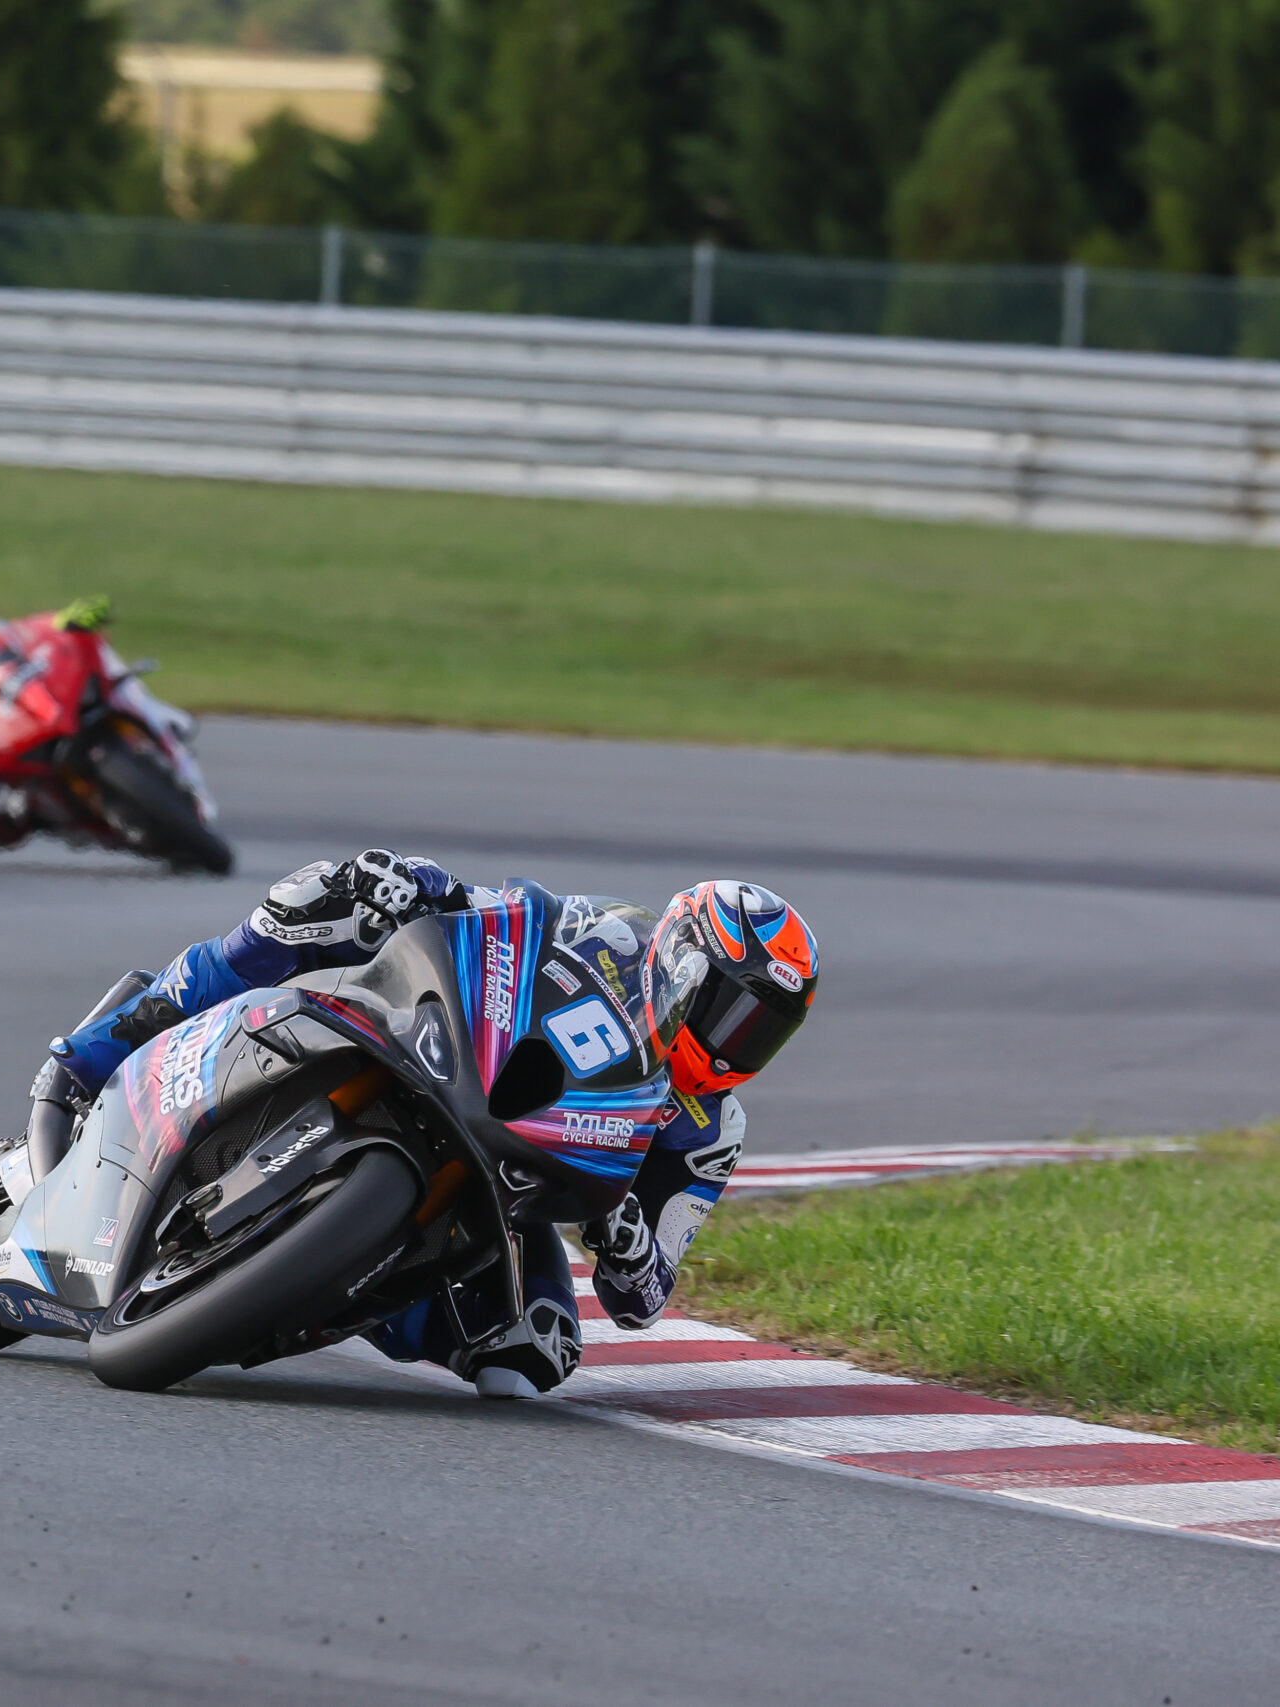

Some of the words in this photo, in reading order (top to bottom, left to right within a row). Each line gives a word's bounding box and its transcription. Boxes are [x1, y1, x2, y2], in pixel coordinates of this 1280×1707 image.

[260, 917, 333, 940] alpinestars
[486, 934, 497, 972] CYCLE
[484, 972, 496, 1021] RACING
[493, 939, 515, 1032] TYTLERS
[773, 965, 798, 987] BELL
[589, 970, 631, 1026] MOTOAMERICA
[547, 1000, 629, 1070] 6
[160, 1051, 179, 1115] RACING
[562, 1131, 593, 1145] CYCLE
[596, 1136, 630, 1149] RACING
[563, 1112, 635, 1137] TYTLERS
[258, 1126, 330, 1173] DUNLOP
[72, 1257, 115, 1276] DUNLOP
